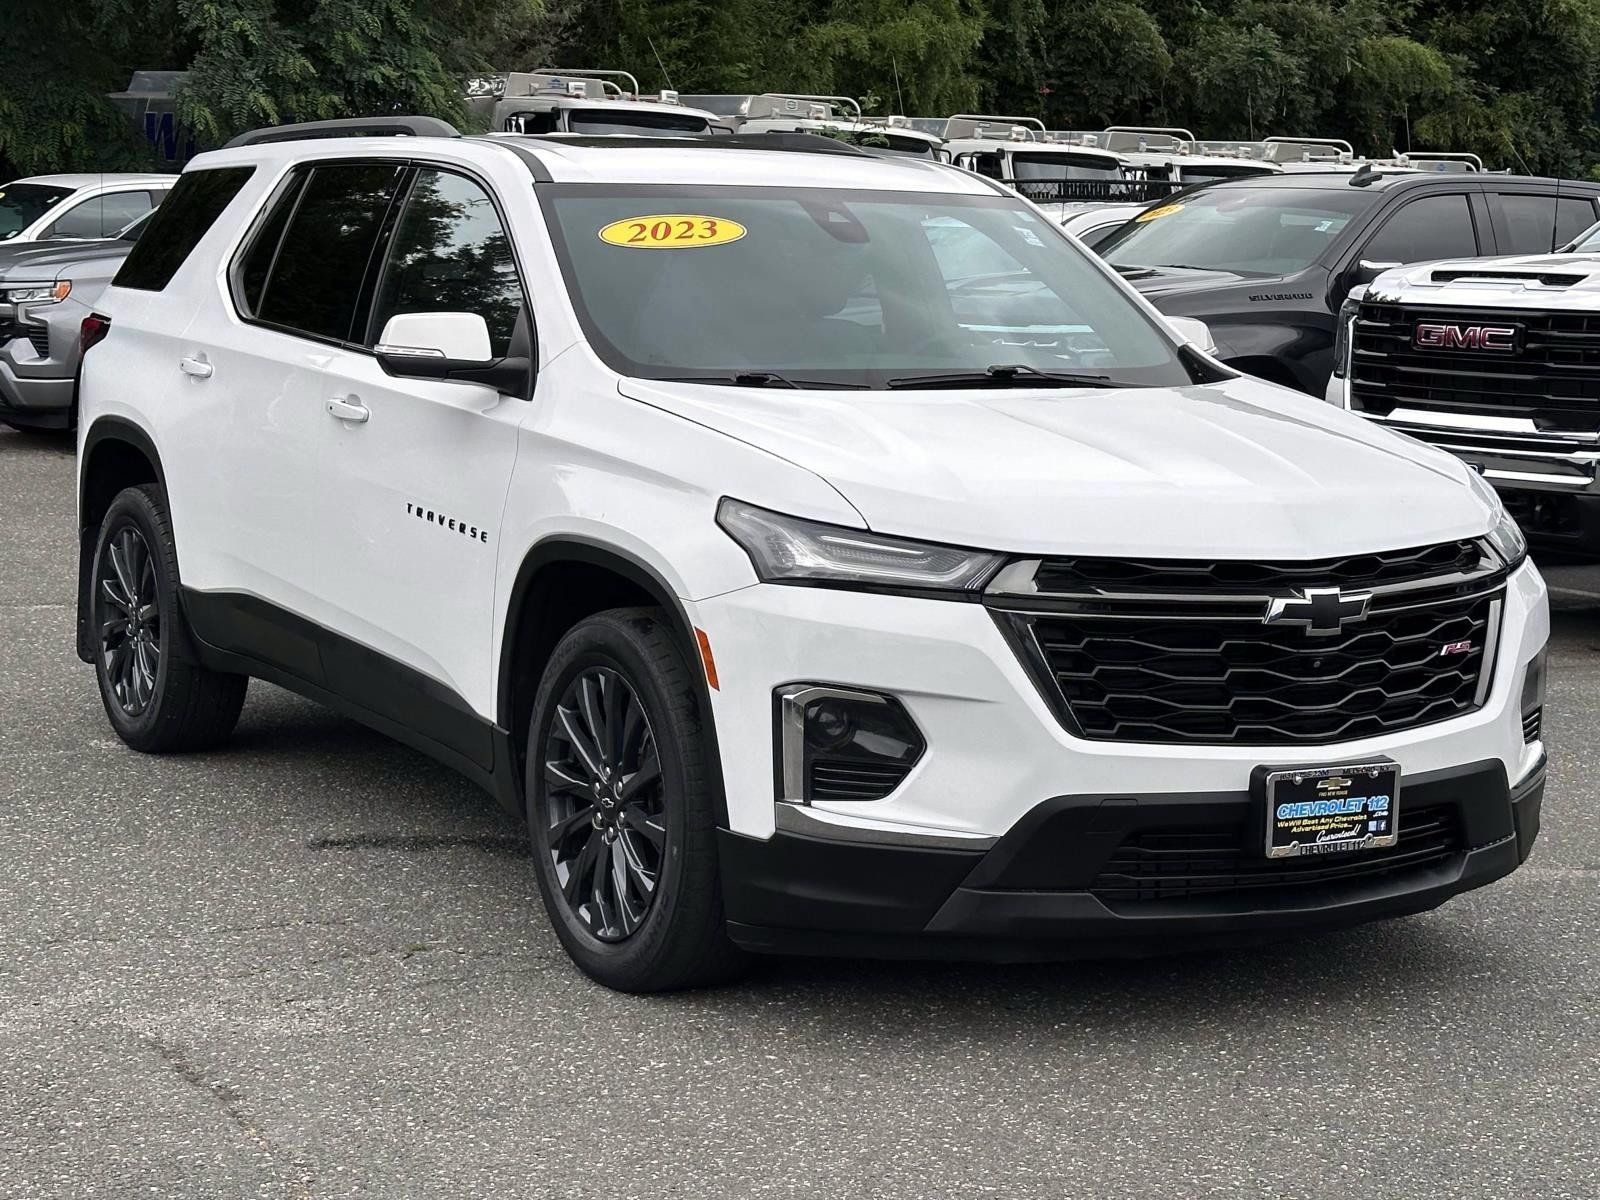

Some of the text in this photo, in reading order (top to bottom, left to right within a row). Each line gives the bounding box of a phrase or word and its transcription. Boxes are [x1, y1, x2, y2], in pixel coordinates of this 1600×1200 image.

[627, 220, 718, 243] 2023
[1416, 324, 1515, 350] GMC
[406, 502, 488, 543] TRAVERSE
[1440, 640, 1472, 656] RS
[1277, 795, 1389, 819] CHEVROLET 112
[1320, 816, 1333, 824] Any
[1334, 814, 1367, 823] Chevrolet
